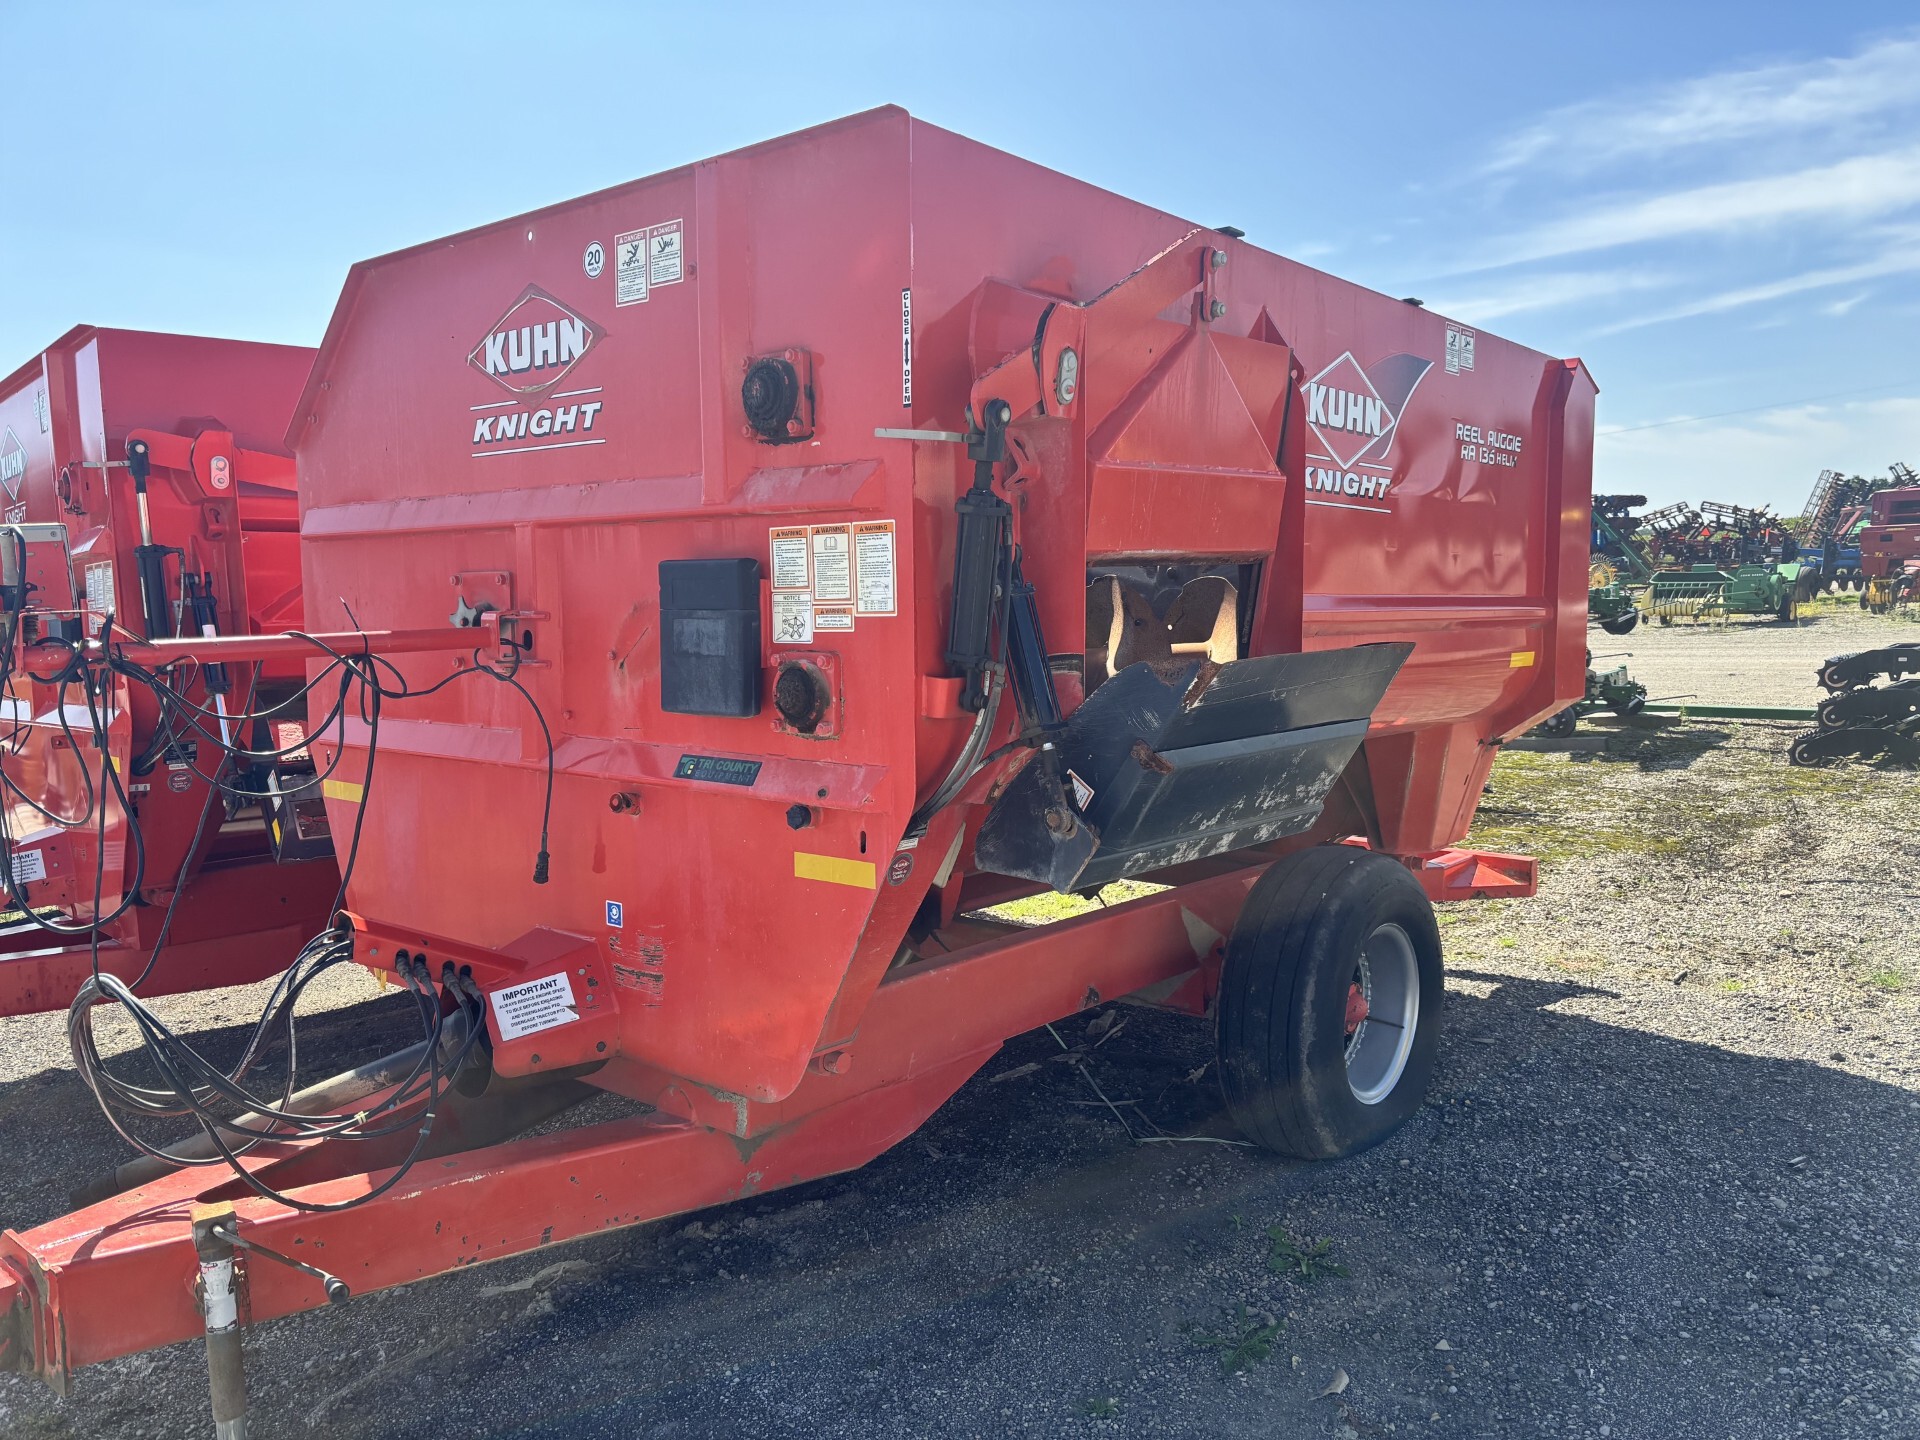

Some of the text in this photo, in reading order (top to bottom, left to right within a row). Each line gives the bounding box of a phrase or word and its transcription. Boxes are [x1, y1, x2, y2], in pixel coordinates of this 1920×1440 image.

[587, 249, 601, 266] 20
[485, 318, 584, 376] KUHN
[1309, 382, 1381, 437] KUHN
[472, 401, 602, 445] KNIGHT
[1456, 422, 1522, 453] REEL AUGGIE
[0, 449, 23, 481] KUHN
[1460, 444, 1476, 462] RA
[1479, 446, 1495, 465] 136
[821, 526, 846, 534] WARNING
[864, 525, 888, 533] WARNING
[694, 769, 752, 783] EQUIPMENT
[698, 759, 715, 769] TRI
[716, 761, 759, 774] COUNTY
[502, 979, 558, 1001] IMPORTANT
[499, 1001, 517, 1010] ALWAYS
